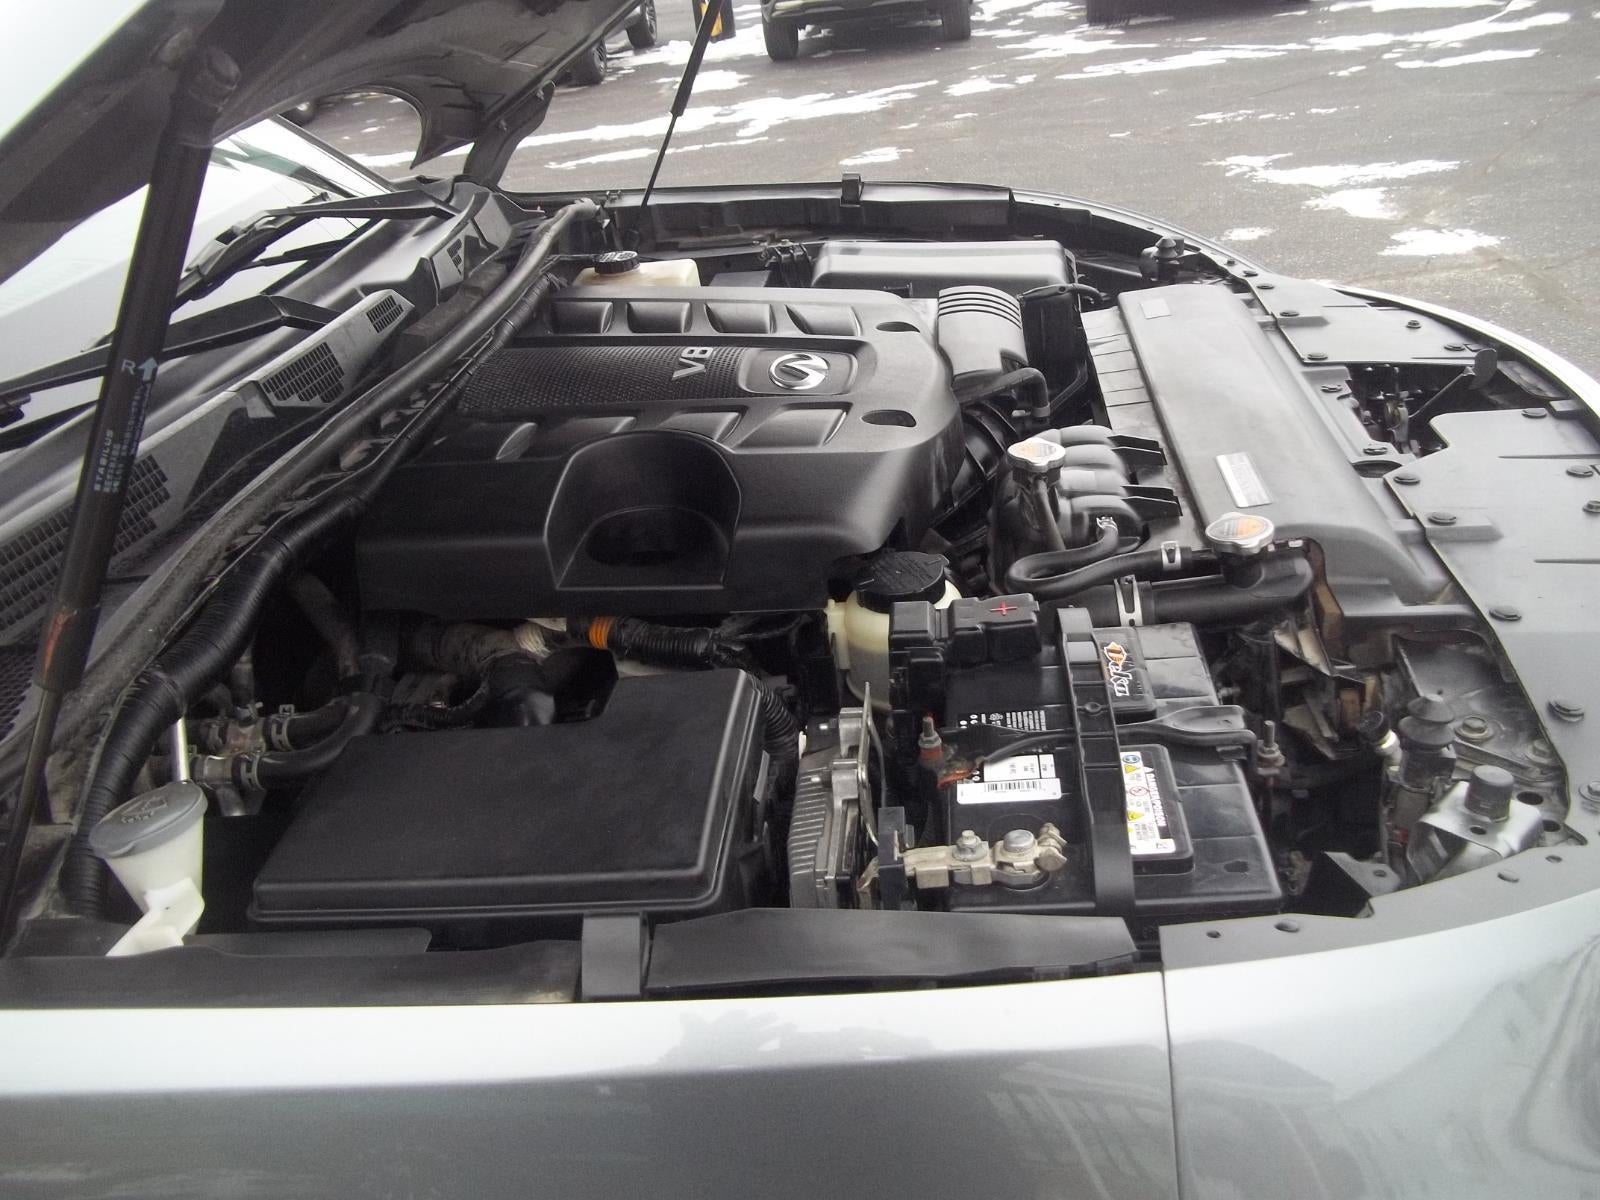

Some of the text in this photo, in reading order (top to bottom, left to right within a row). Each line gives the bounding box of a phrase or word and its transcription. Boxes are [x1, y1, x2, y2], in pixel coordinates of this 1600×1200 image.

[121, 359, 136, 375] R
[672, 346, 713, 380] V8
[94, 429, 114, 491] STABILUS
[1104, 641, 1133, 697] Deka
